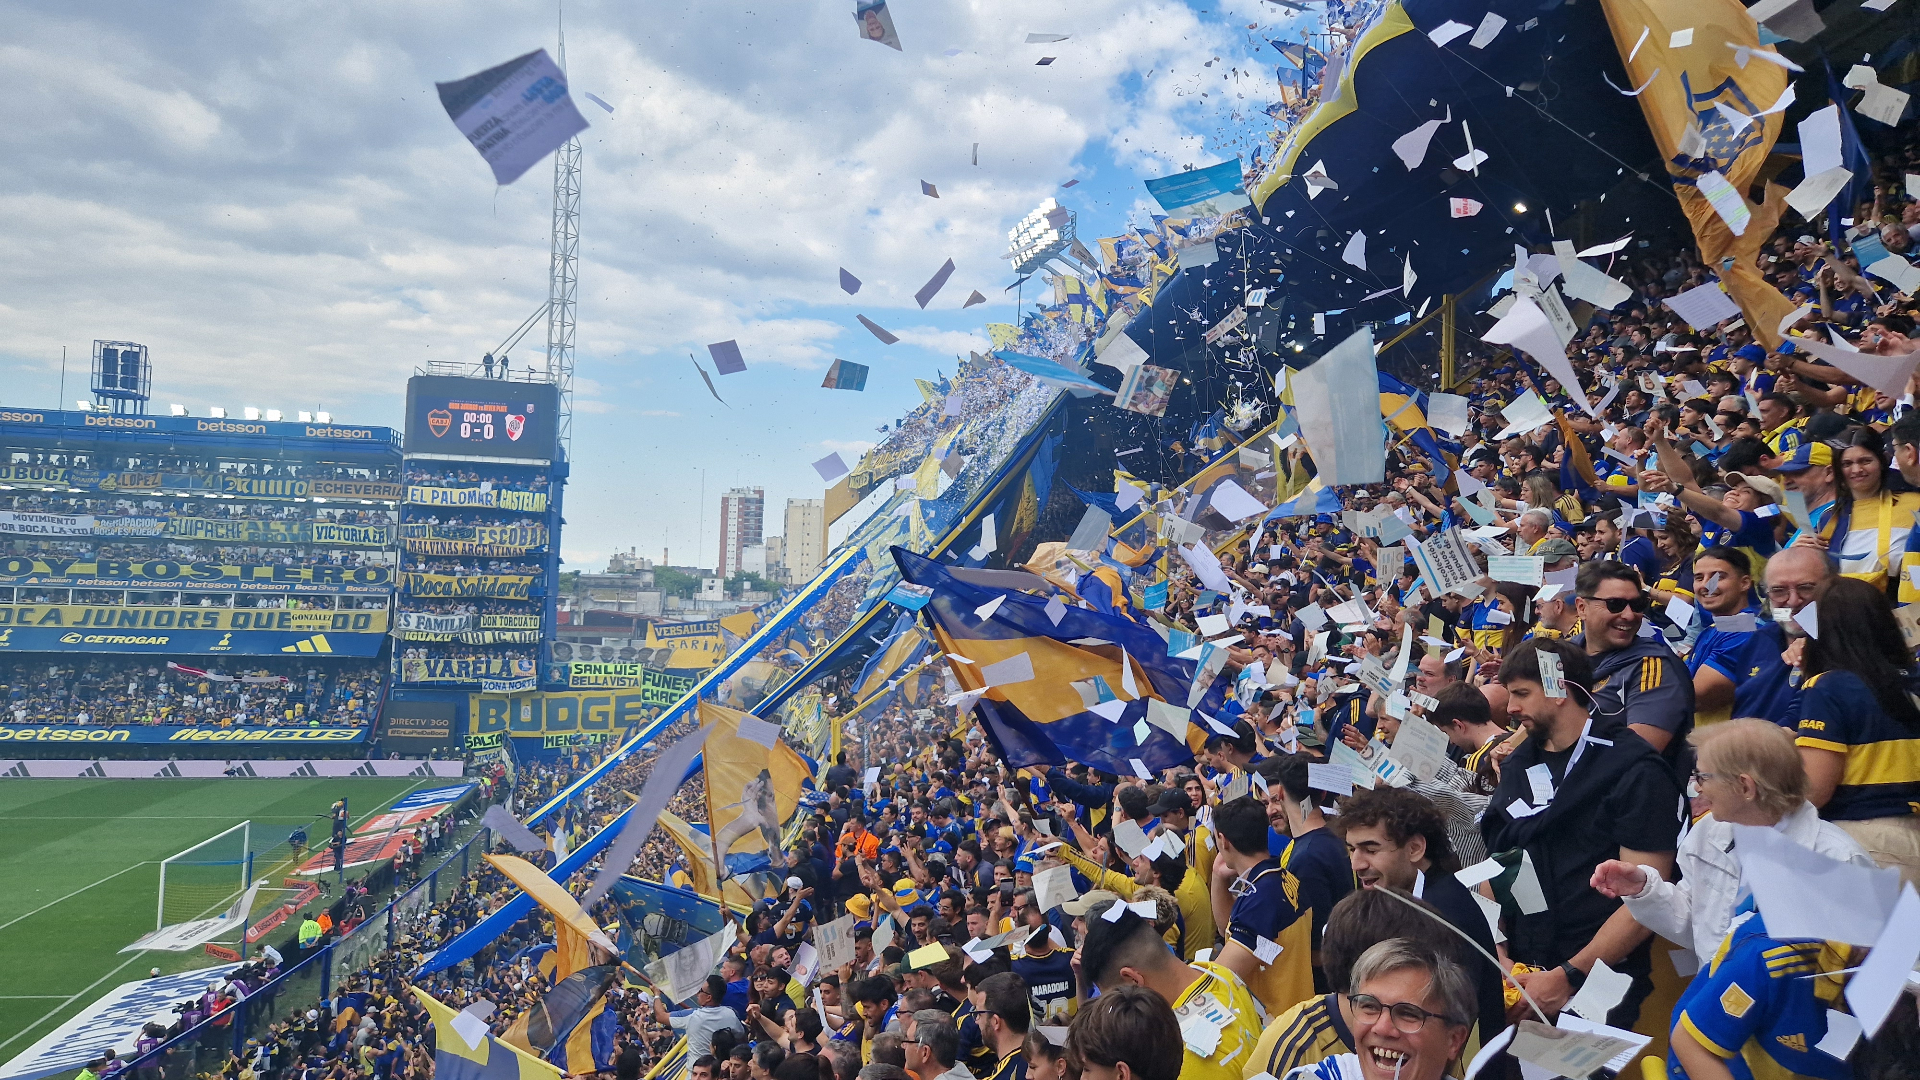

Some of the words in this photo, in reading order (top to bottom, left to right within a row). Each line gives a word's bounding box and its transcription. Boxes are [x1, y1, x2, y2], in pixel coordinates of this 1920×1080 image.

[85, 414, 156, 428] betsson
[464, 412, 492, 424] 00:00
[197, 420, 266, 434] betsson
[306, 426, 372, 439] betsson
[13, 467, 69, 482] BOCA
[411, 488, 427, 503] EL
[432, 489, 494, 506] PALOMAR
[500, 489, 546, 512] CASTELAR
[12, 514, 77, 525] MOVIMIENTO
[18, 524, 48, 534] BOCA
[51, 526, 67, 535] LA
[94, 527, 115, 536] BOCA
[118, 528, 129, 536] ES
[315, 525, 371, 543] VICTORIA
[249, 532, 312, 543] BROWN
[1443, 539, 1451, 549] de
[409, 540, 459, 555] MALVINAS
[462, 542, 525, 557] ARGENTINAS
[95, 558, 389, 584] BOSTERO
[1427, 542, 1452, 588] Recolección
[1440, 551, 1459, 584] residuos
[1449, 550, 1468, 581] después
[77, 579, 128, 587] betsson
[131, 580, 182, 588] betsson
[186, 581, 237, 589] betsson
[240, 583, 290, 591] betsson
[412, 574, 453, 596] Boca
[455, 577, 530, 598] Solidario
[73, 609, 219, 628] JUNIORS
[415, 615, 471, 632] FAMILIA
[483, 616, 498, 627] DON
[500, 616, 538, 627] TORCUATO
[655, 623, 719, 637] VERSAILLES
[84, 635, 170, 645] CETROGAR
[424, 659, 514, 677] VARELA
[574, 664, 601, 675] SAN
[603, 664, 639, 676] LUIS
[483, 681, 507, 691] ZONA
[509, 678, 536, 690] NORTE
[572, 675, 608, 686] BELLA
[609, 676, 640, 687] VISTA
[642, 670, 695, 691] FUNES
[479, 695, 642, 732] BUDGE
[390, 718, 427, 726] DIRECTV
[0, 726, 130, 741] betsson
[465, 733, 503, 749] SALTA
[1032, 981, 1069, 996] MARADONA
